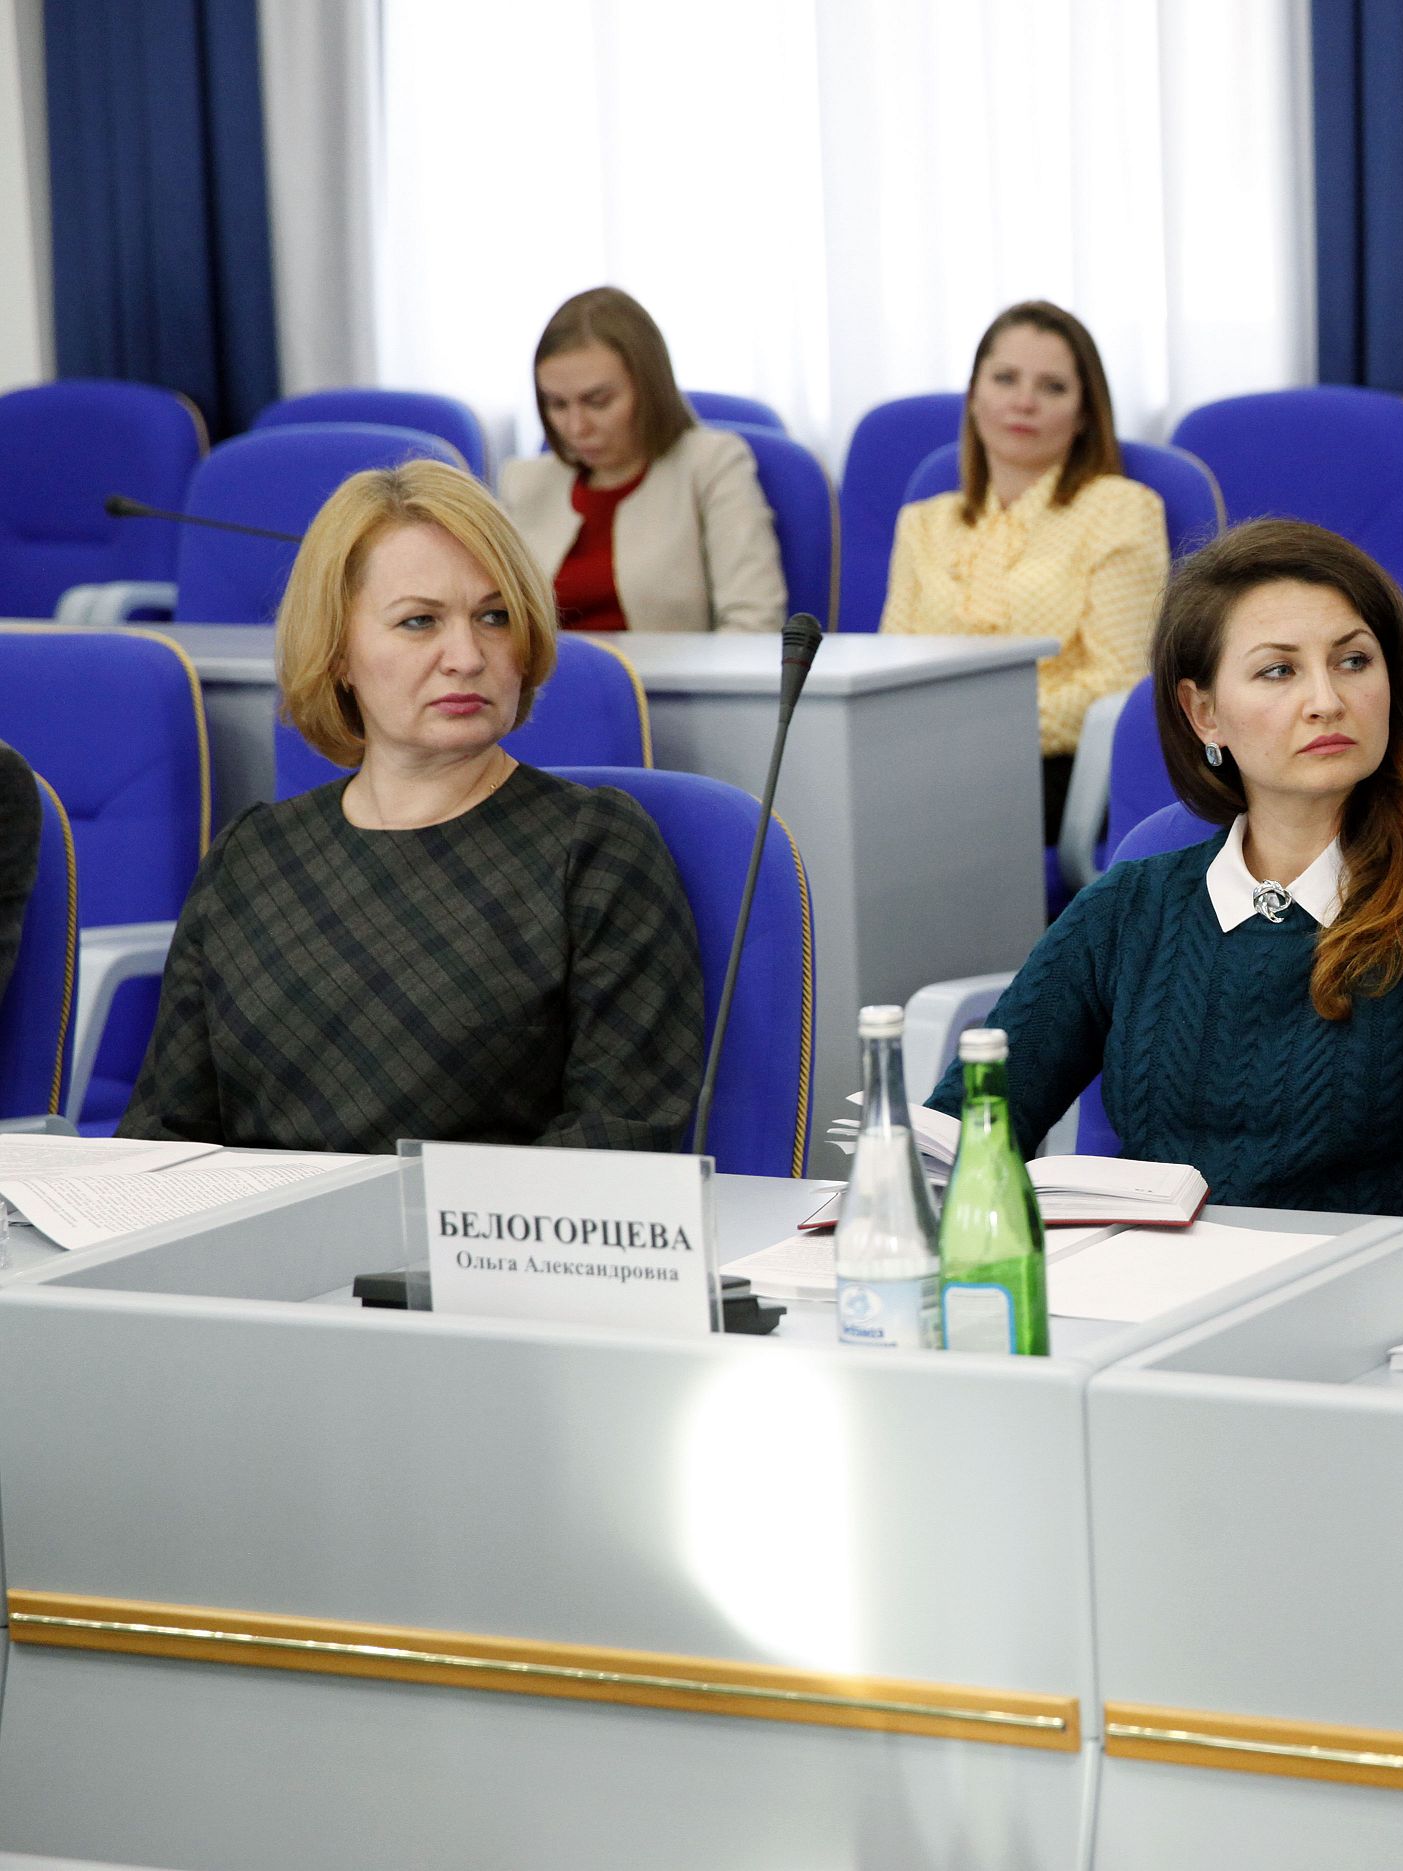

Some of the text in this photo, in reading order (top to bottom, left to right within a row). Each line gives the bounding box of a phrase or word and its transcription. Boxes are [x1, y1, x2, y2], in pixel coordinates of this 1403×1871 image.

[438, 1209, 694, 1252] БЕЛОГОРЦЕВА
[456, 1250, 679, 1284] Ольга Александровна
